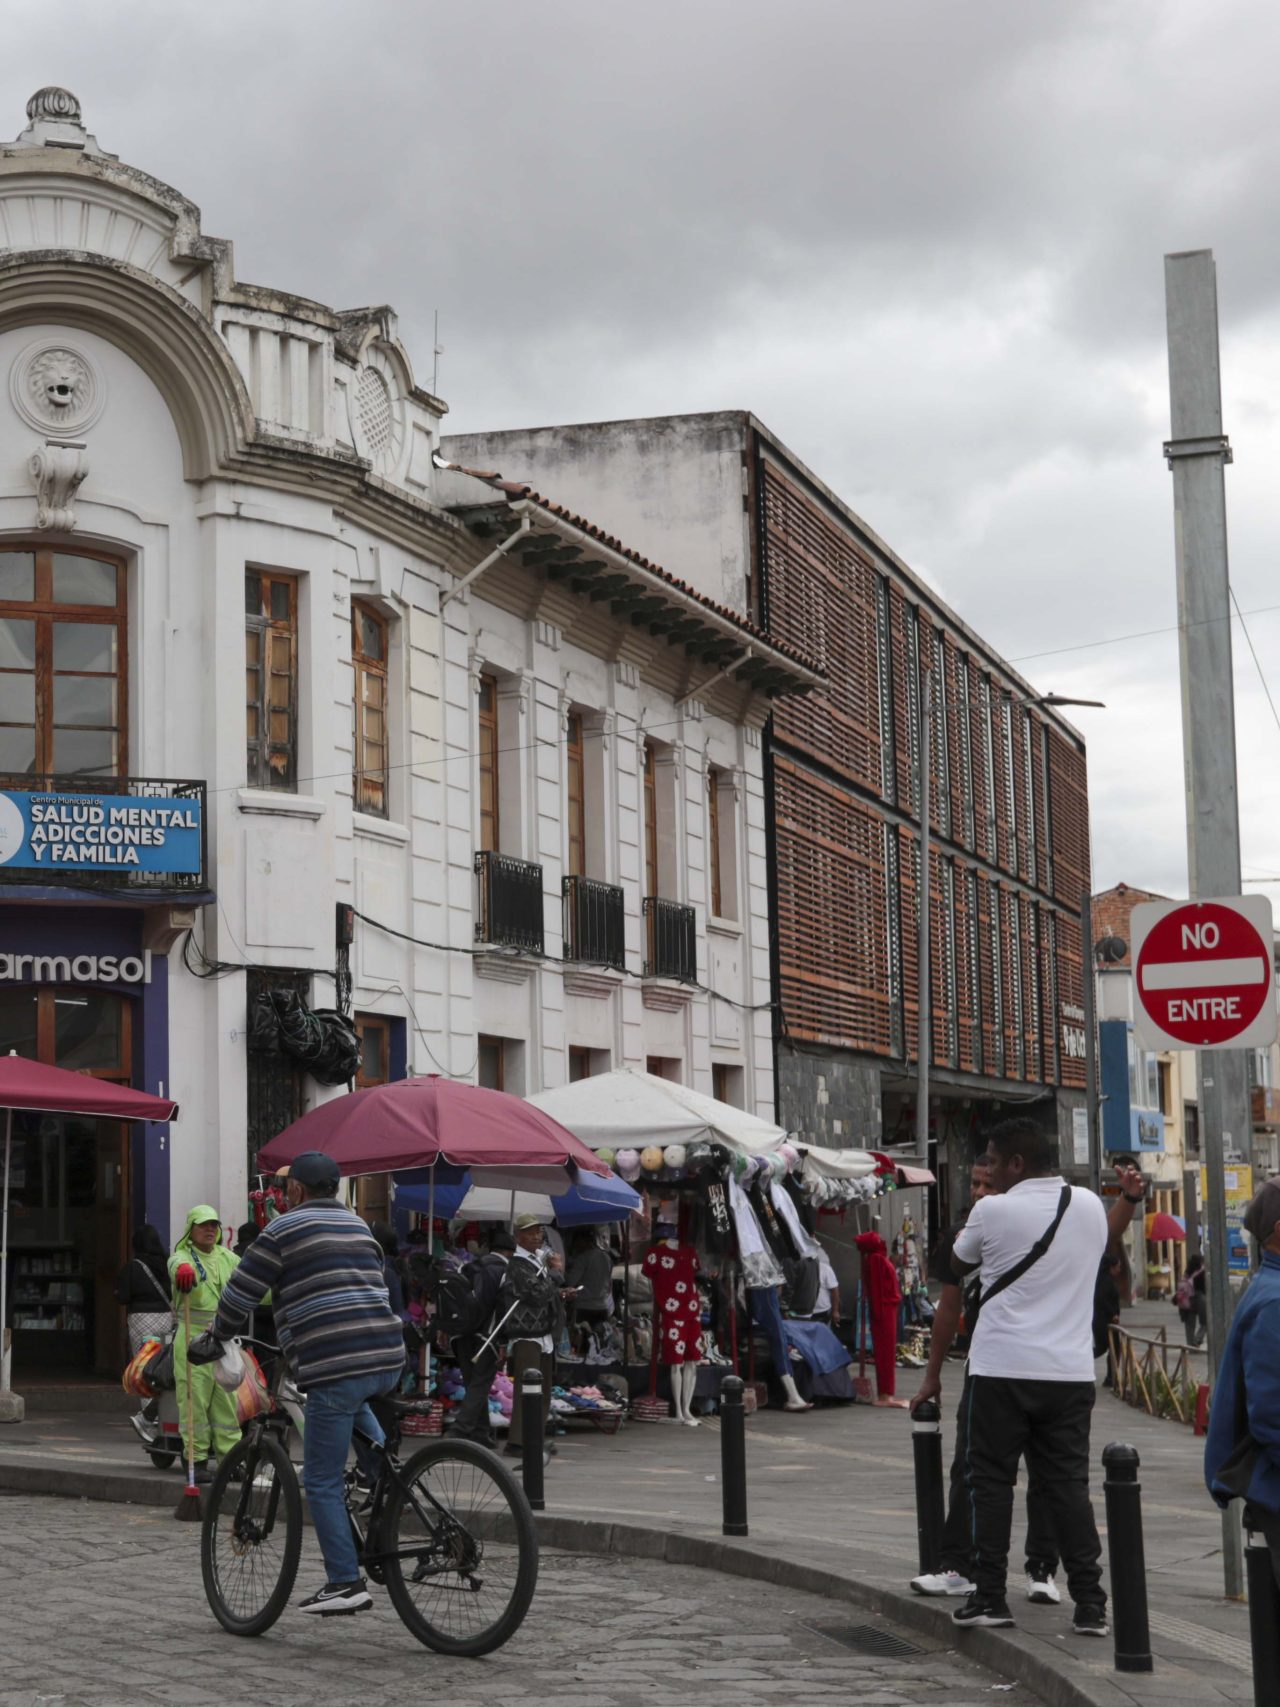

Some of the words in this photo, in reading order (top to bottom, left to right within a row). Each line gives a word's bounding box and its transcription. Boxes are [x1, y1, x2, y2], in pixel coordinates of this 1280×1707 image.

[30, 796, 56, 805] Centro
[58, 796, 93, 807] Municipal
[94, 798, 104, 806] de
[30, 805, 105, 825] SALUD
[109, 808, 198, 828] MENTAL
[30, 825, 165, 846] ADICCIONES
[30, 843, 45, 862] Y
[51, 844, 140, 864] FAMILIA
[1181, 922, 1220, 951] NO
[1167, 997, 1242, 1023] ENTRE
